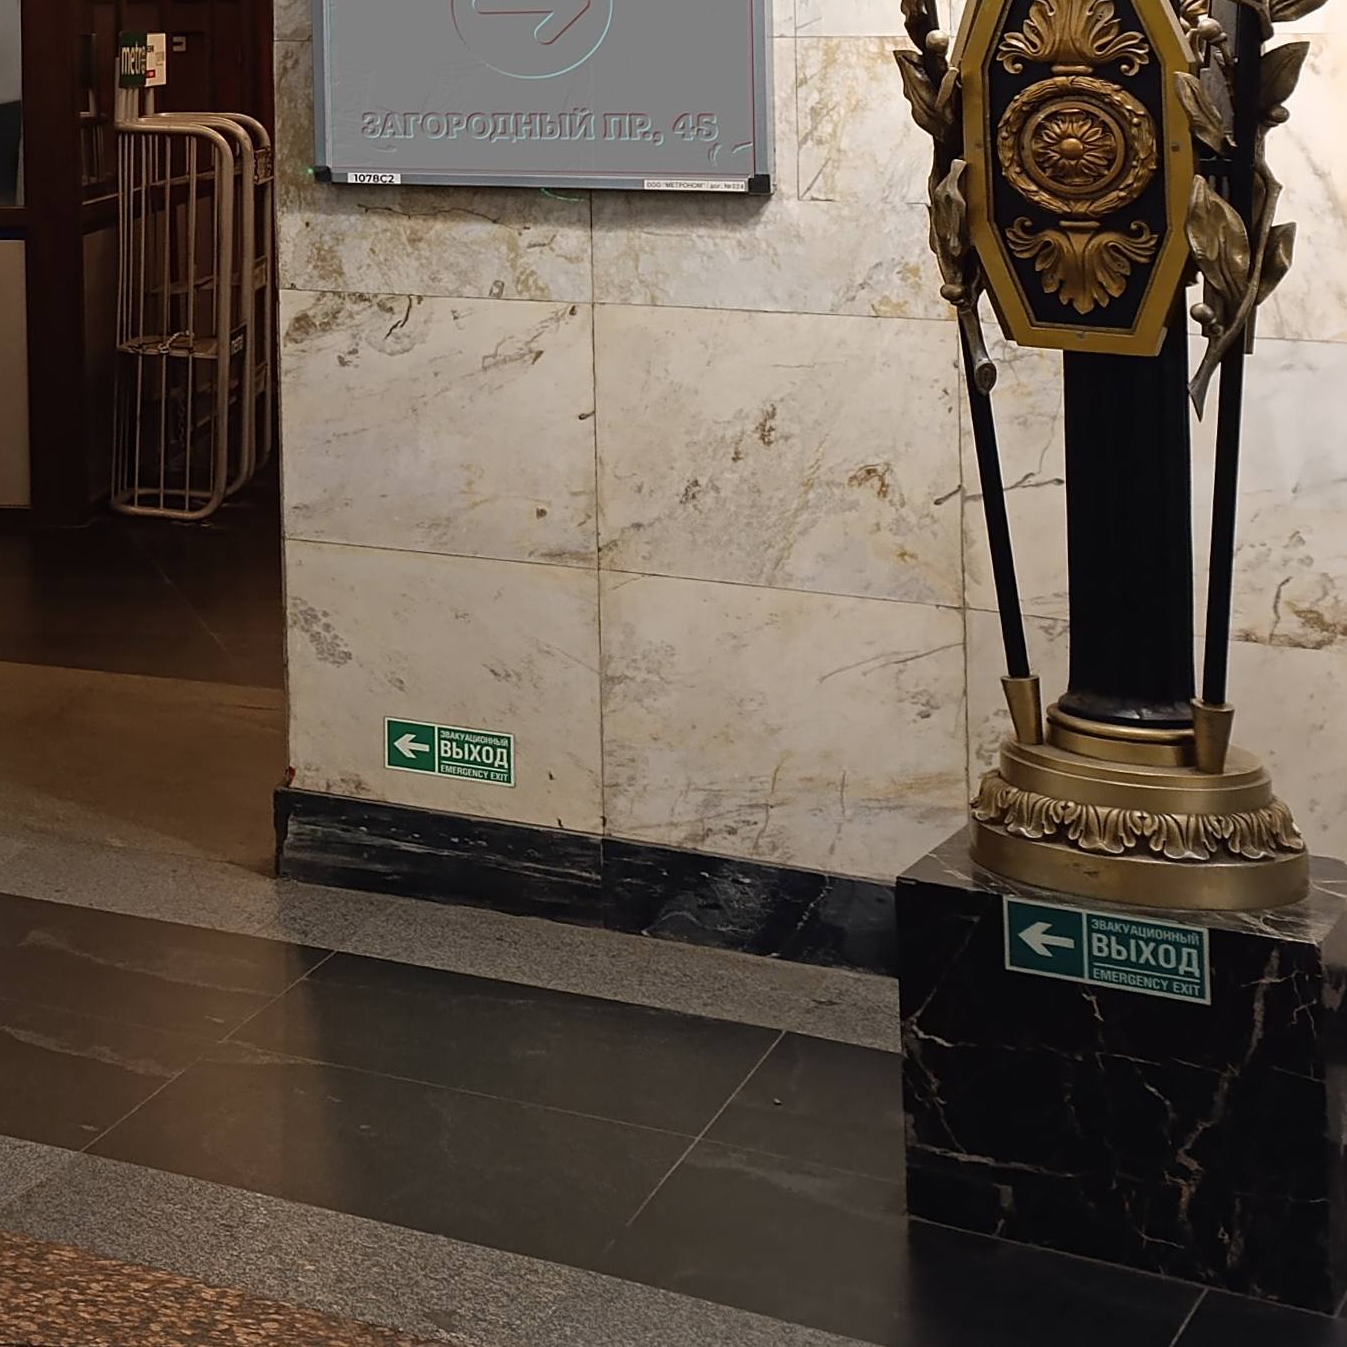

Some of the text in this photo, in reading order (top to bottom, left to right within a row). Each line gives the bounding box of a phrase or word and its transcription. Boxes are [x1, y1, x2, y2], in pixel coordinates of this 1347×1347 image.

[362, 107, 595, 145] ЗАГОРОДНЫЙ
[673, 112, 720, 142] 45
[440, 730, 508, 746] ЭВАКУАЦИОННЫЙ
[440, 740, 509, 769] ВЫХОД
[441, 765, 508, 781] EMERGENCY EXIT
[1091, 918, 1200, 946] ЭВАКУАЦИОННЫЙ
[1091, 933, 1201, 978] ВЫХОД
[1093, 967, 1201, 996] EMERGENCY EXIT
